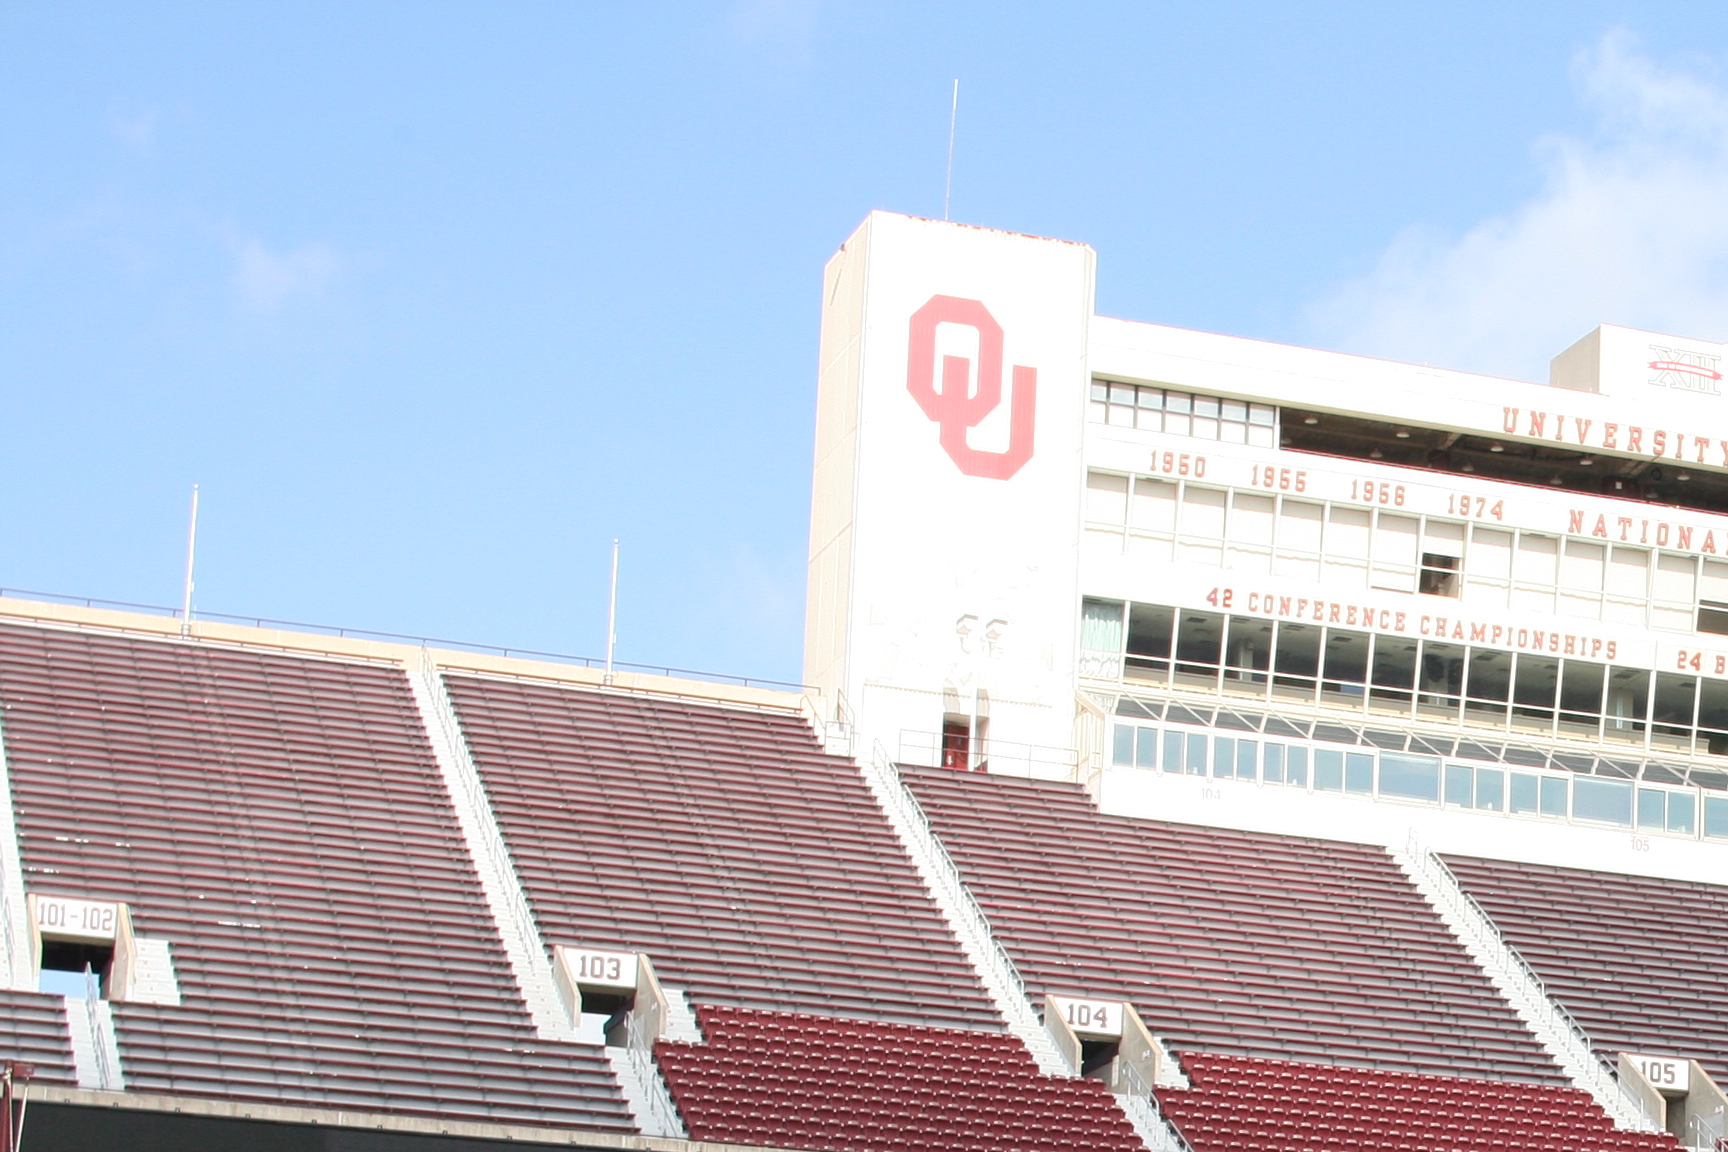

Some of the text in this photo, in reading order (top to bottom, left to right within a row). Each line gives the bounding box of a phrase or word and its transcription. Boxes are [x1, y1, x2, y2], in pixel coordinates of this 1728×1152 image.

[1150, 450, 1206, 478] 1950
[1252, 464, 1306, 492] 1955
[1351, 479, 1405, 506] 1956
[1448, 493, 1504, 520] 1974
[1206, 587, 1617, 661] 42 CONFERENCE CHAMPIONSHIPS
[1677, 650, 1701, 671] 24
[1631, 839, 1649, 851] 105
[39, 902, 113, 931] 101-102
[579, 955, 621, 980] 103
[1068, 1003, 1108, 1029] 104
[1641, 1061, 1675, 1084] 105
